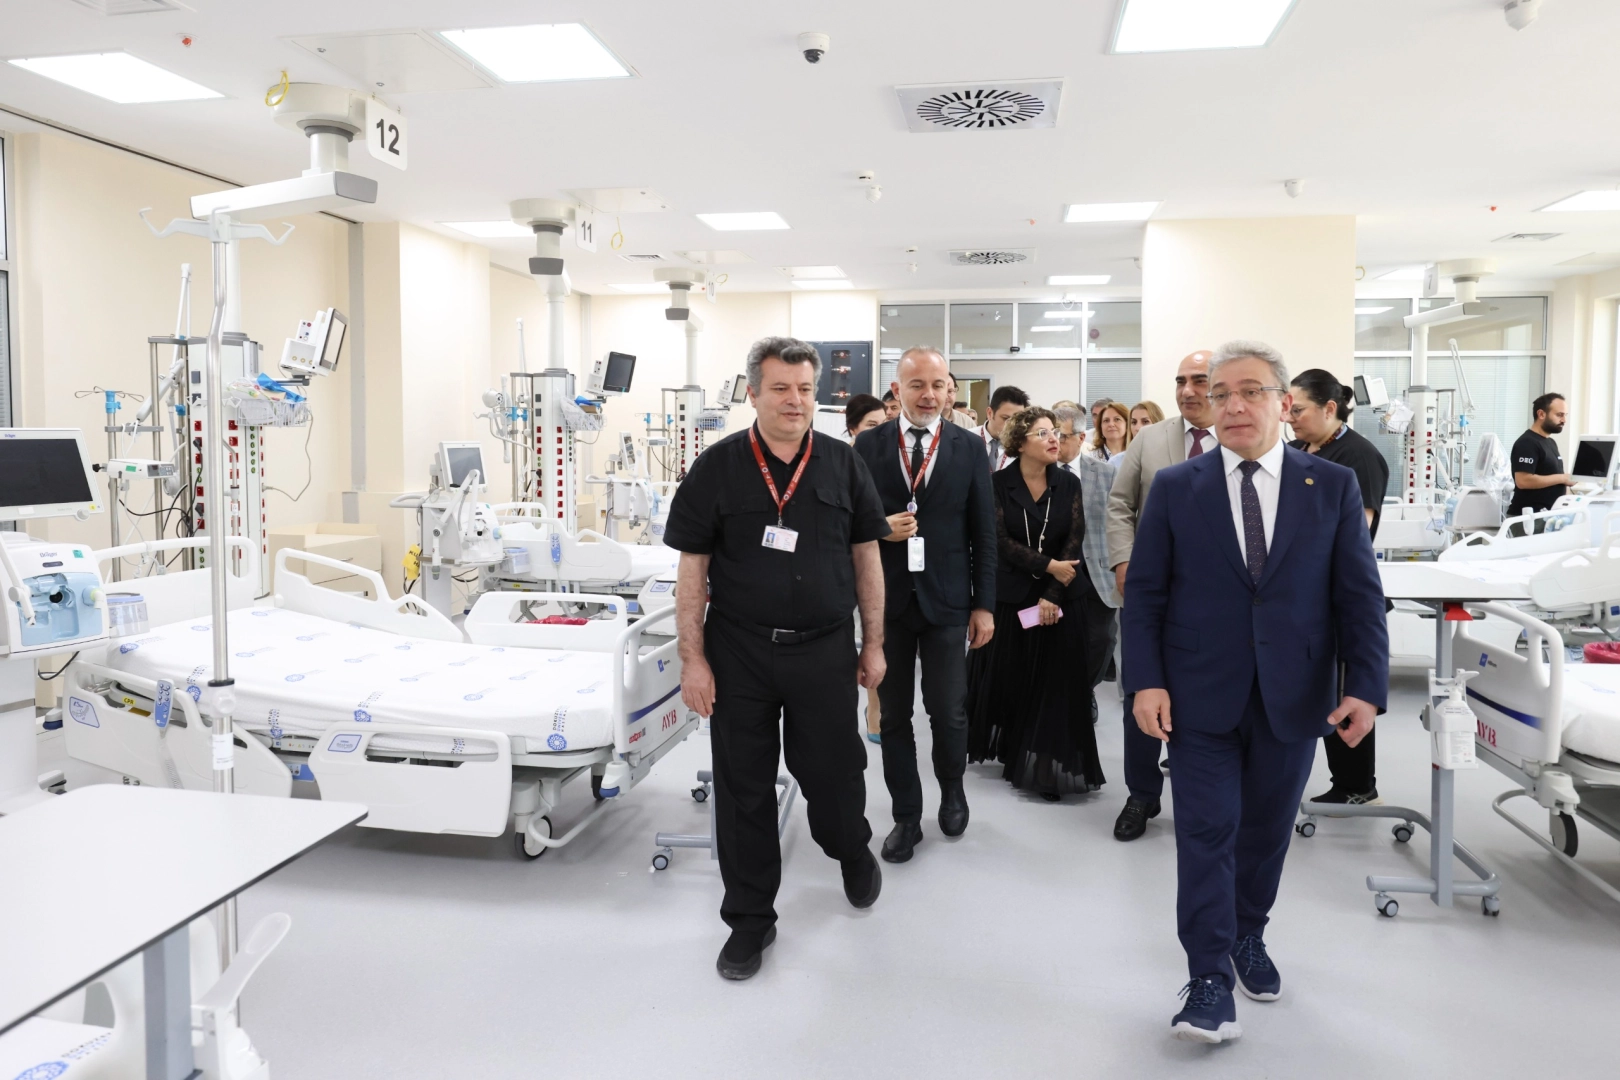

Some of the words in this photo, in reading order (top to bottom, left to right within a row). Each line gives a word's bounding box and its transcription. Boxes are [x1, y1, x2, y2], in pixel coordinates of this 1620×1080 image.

[376, 118, 400, 156] 12
[581, 220, 592, 243] 11
[123, 697, 134, 705] CPR
[661, 709, 677, 731] AYB
